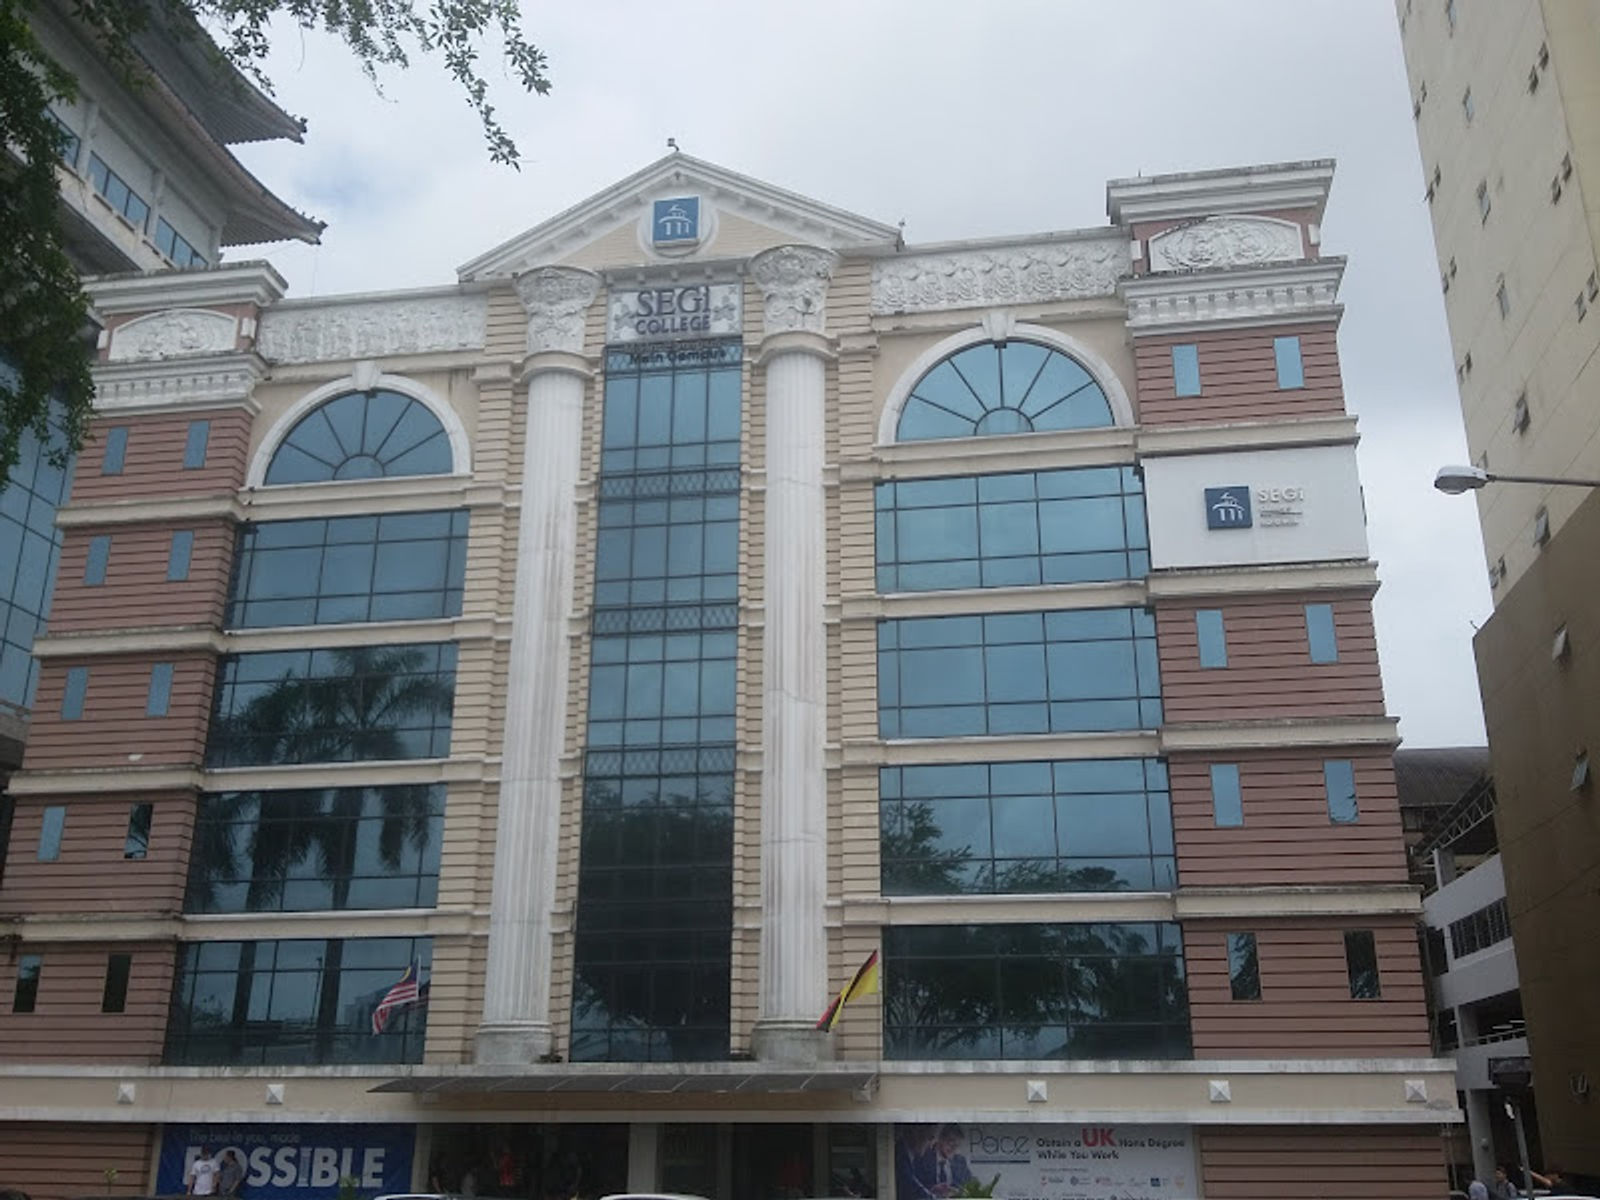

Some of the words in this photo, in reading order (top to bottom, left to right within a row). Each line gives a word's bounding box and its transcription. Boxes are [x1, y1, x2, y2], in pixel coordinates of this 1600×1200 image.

[635, 315, 711, 335] COLLEGE
[1073, 1139, 1081, 1148] a
[1081, 1128, 1117, 1147] UK
[1148, 1138, 1185, 1149] Degree
[1070, 1150, 1089, 1159] You
[1092, 1150, 1119, 1159] Work
